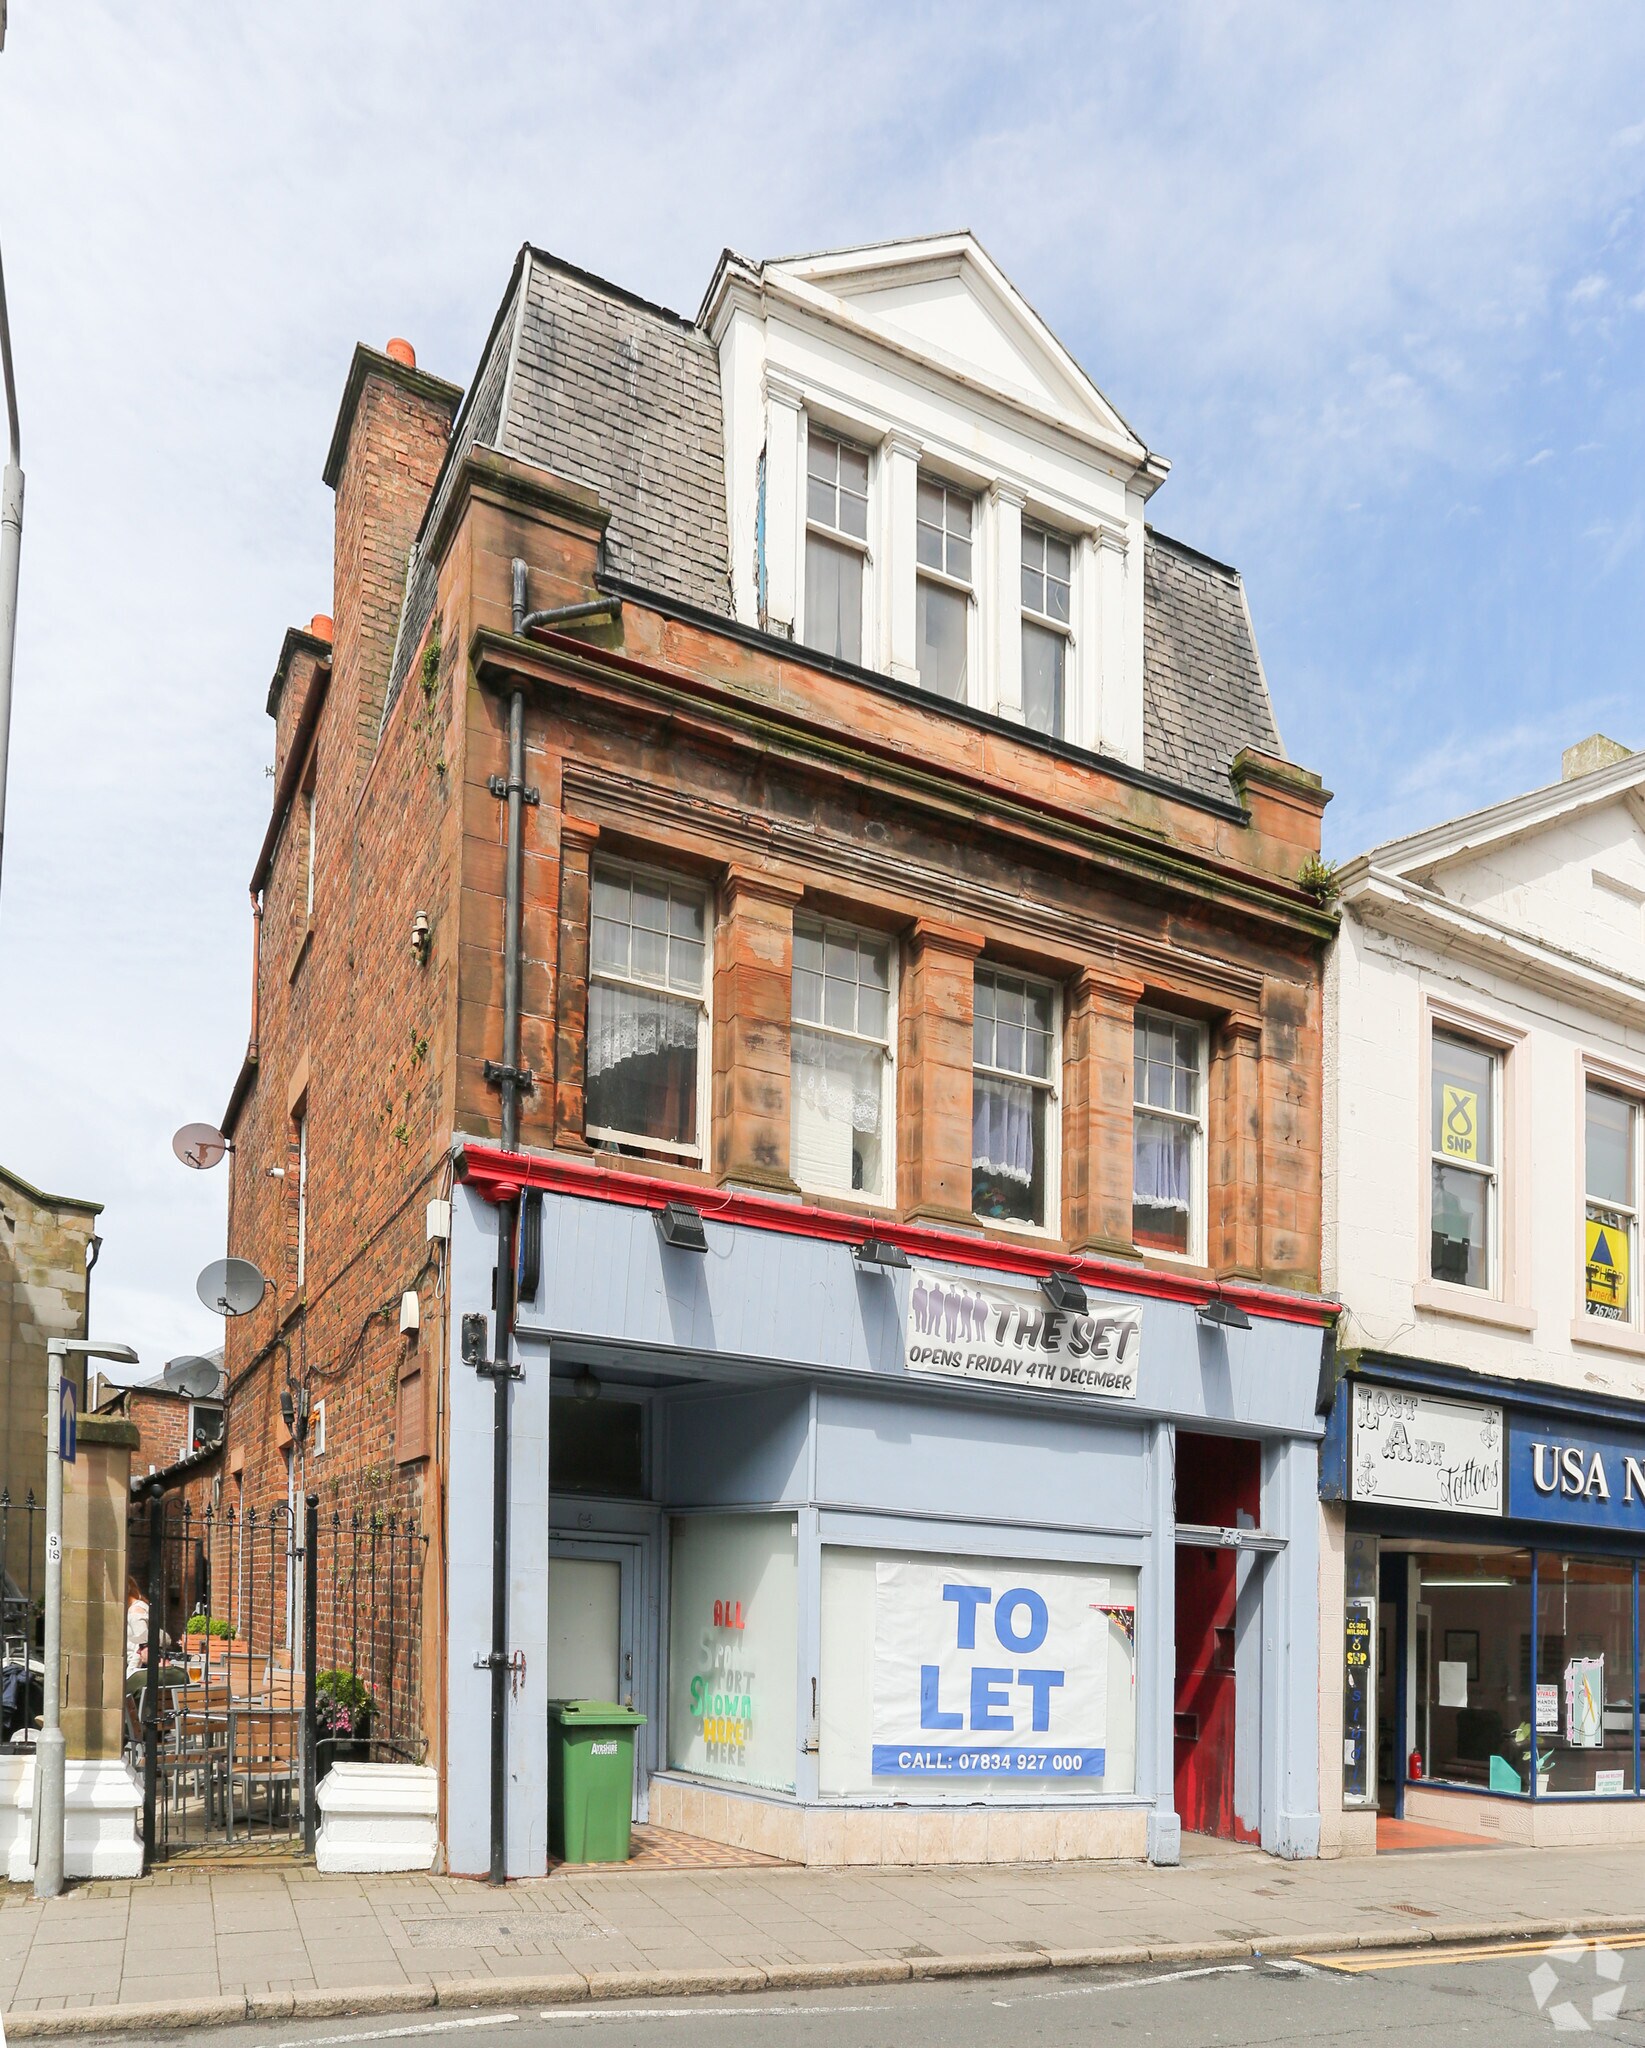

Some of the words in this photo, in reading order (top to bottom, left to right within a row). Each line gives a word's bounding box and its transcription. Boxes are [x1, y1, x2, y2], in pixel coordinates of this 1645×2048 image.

[1446, 1135, 1472, 1154] SNP
[990, 1303, 1068, 1352] THE
[1067, 1315, 1139, 1363] SET
[1594, 1303, 1622, 1320] 267987
[909, 1346, 963, 1368] OPENS
[965, 1353, 1024, 1376] FRIDAY
[1026, 1362, 1057, 1381] 4TH
[1060, 1366, 1132, 1391] DECEMBER
[1357, 1387, 1419, 1430] LOST
[1381, 1421, 1445, 1466] ART
[1437, 1457, 1498, 1507] Tattoos
[1531, 1442, 1611, 1498] USA
[713, 1600, 745, 1630] ALL
[942, 1584, 1049, 1654] TO
[920, 1664, 1065, 1732] LET
[703, 1718, 744, 1746] HERE
[898, 1751, 952, 1769] CALL:
[958, 1753, 1011, 1770] 07834
[1017, 1754, 1047, 1770] 927
[1052, 1755, 1083, 1771] 000
